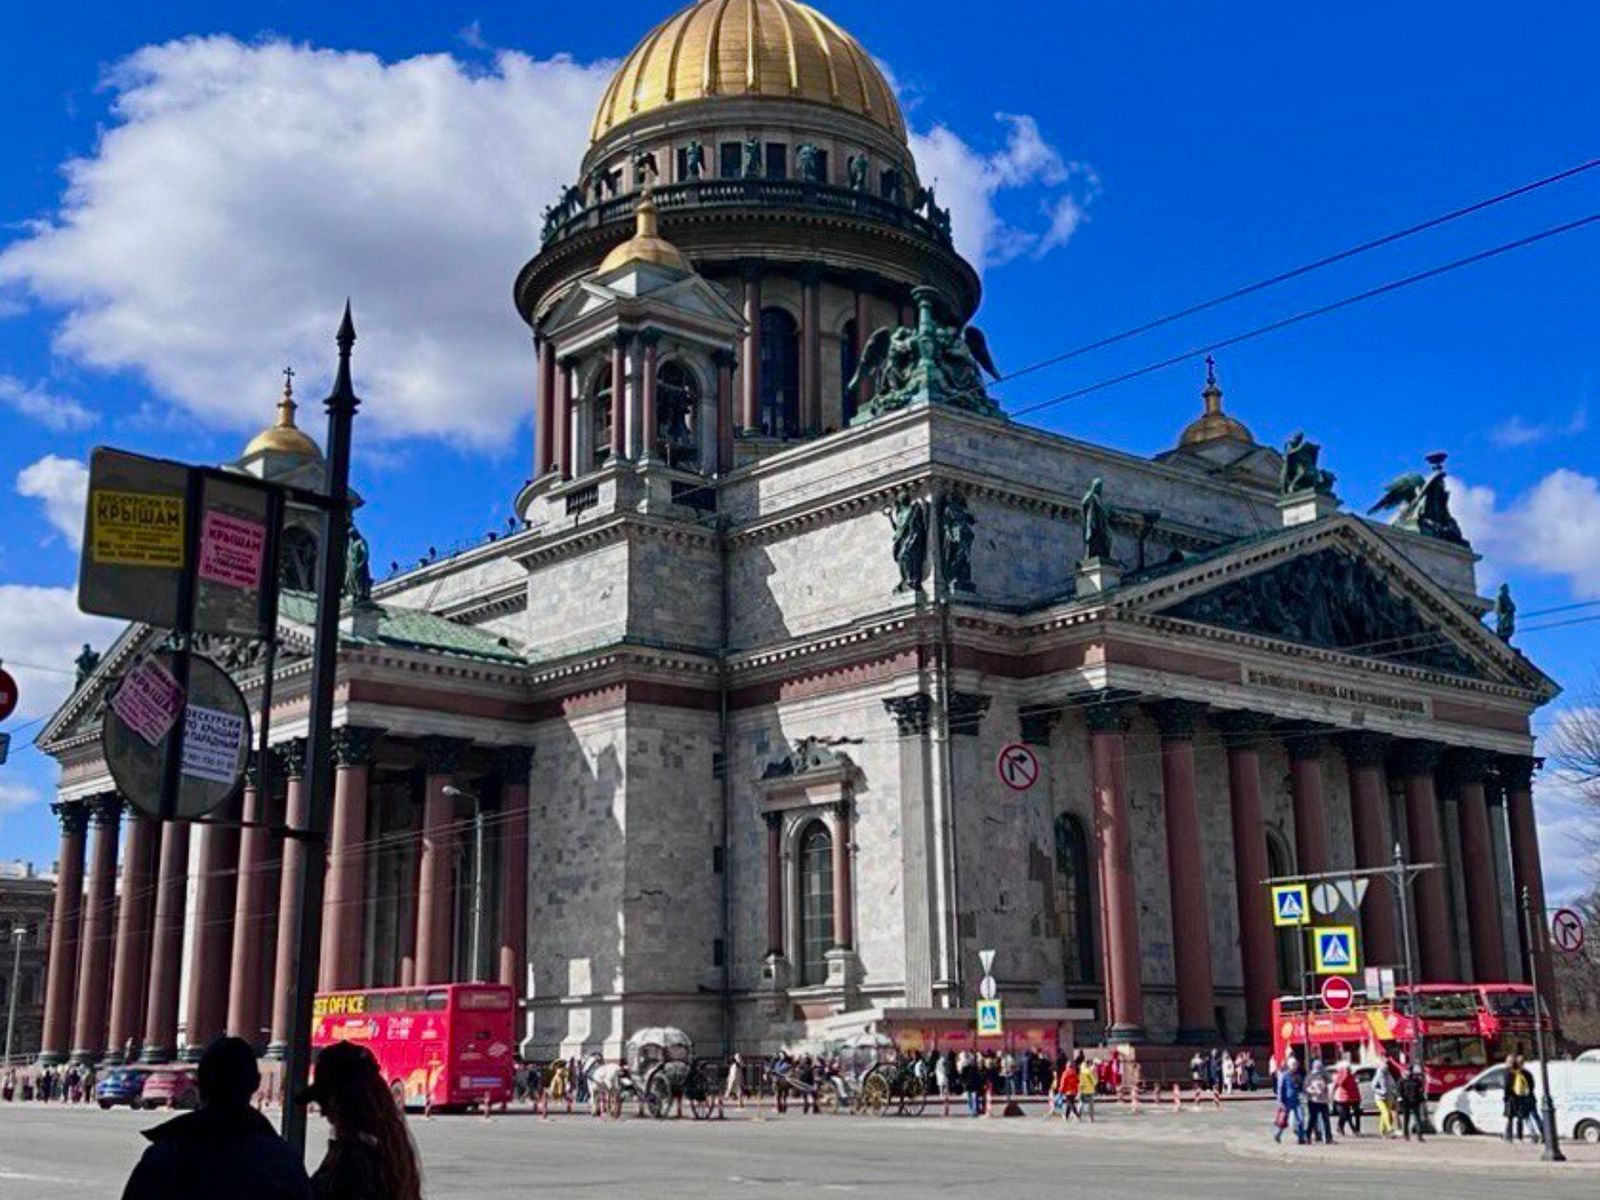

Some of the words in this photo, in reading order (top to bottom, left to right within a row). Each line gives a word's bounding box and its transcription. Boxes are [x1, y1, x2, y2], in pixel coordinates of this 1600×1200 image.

[163, 498, 181, 510] ПО
[98, 504, 180, 527] КРЫШАМ
[209, 528, 261, 552] КРЫШАМ
[328, 994, 364, 1014] OFFICE
